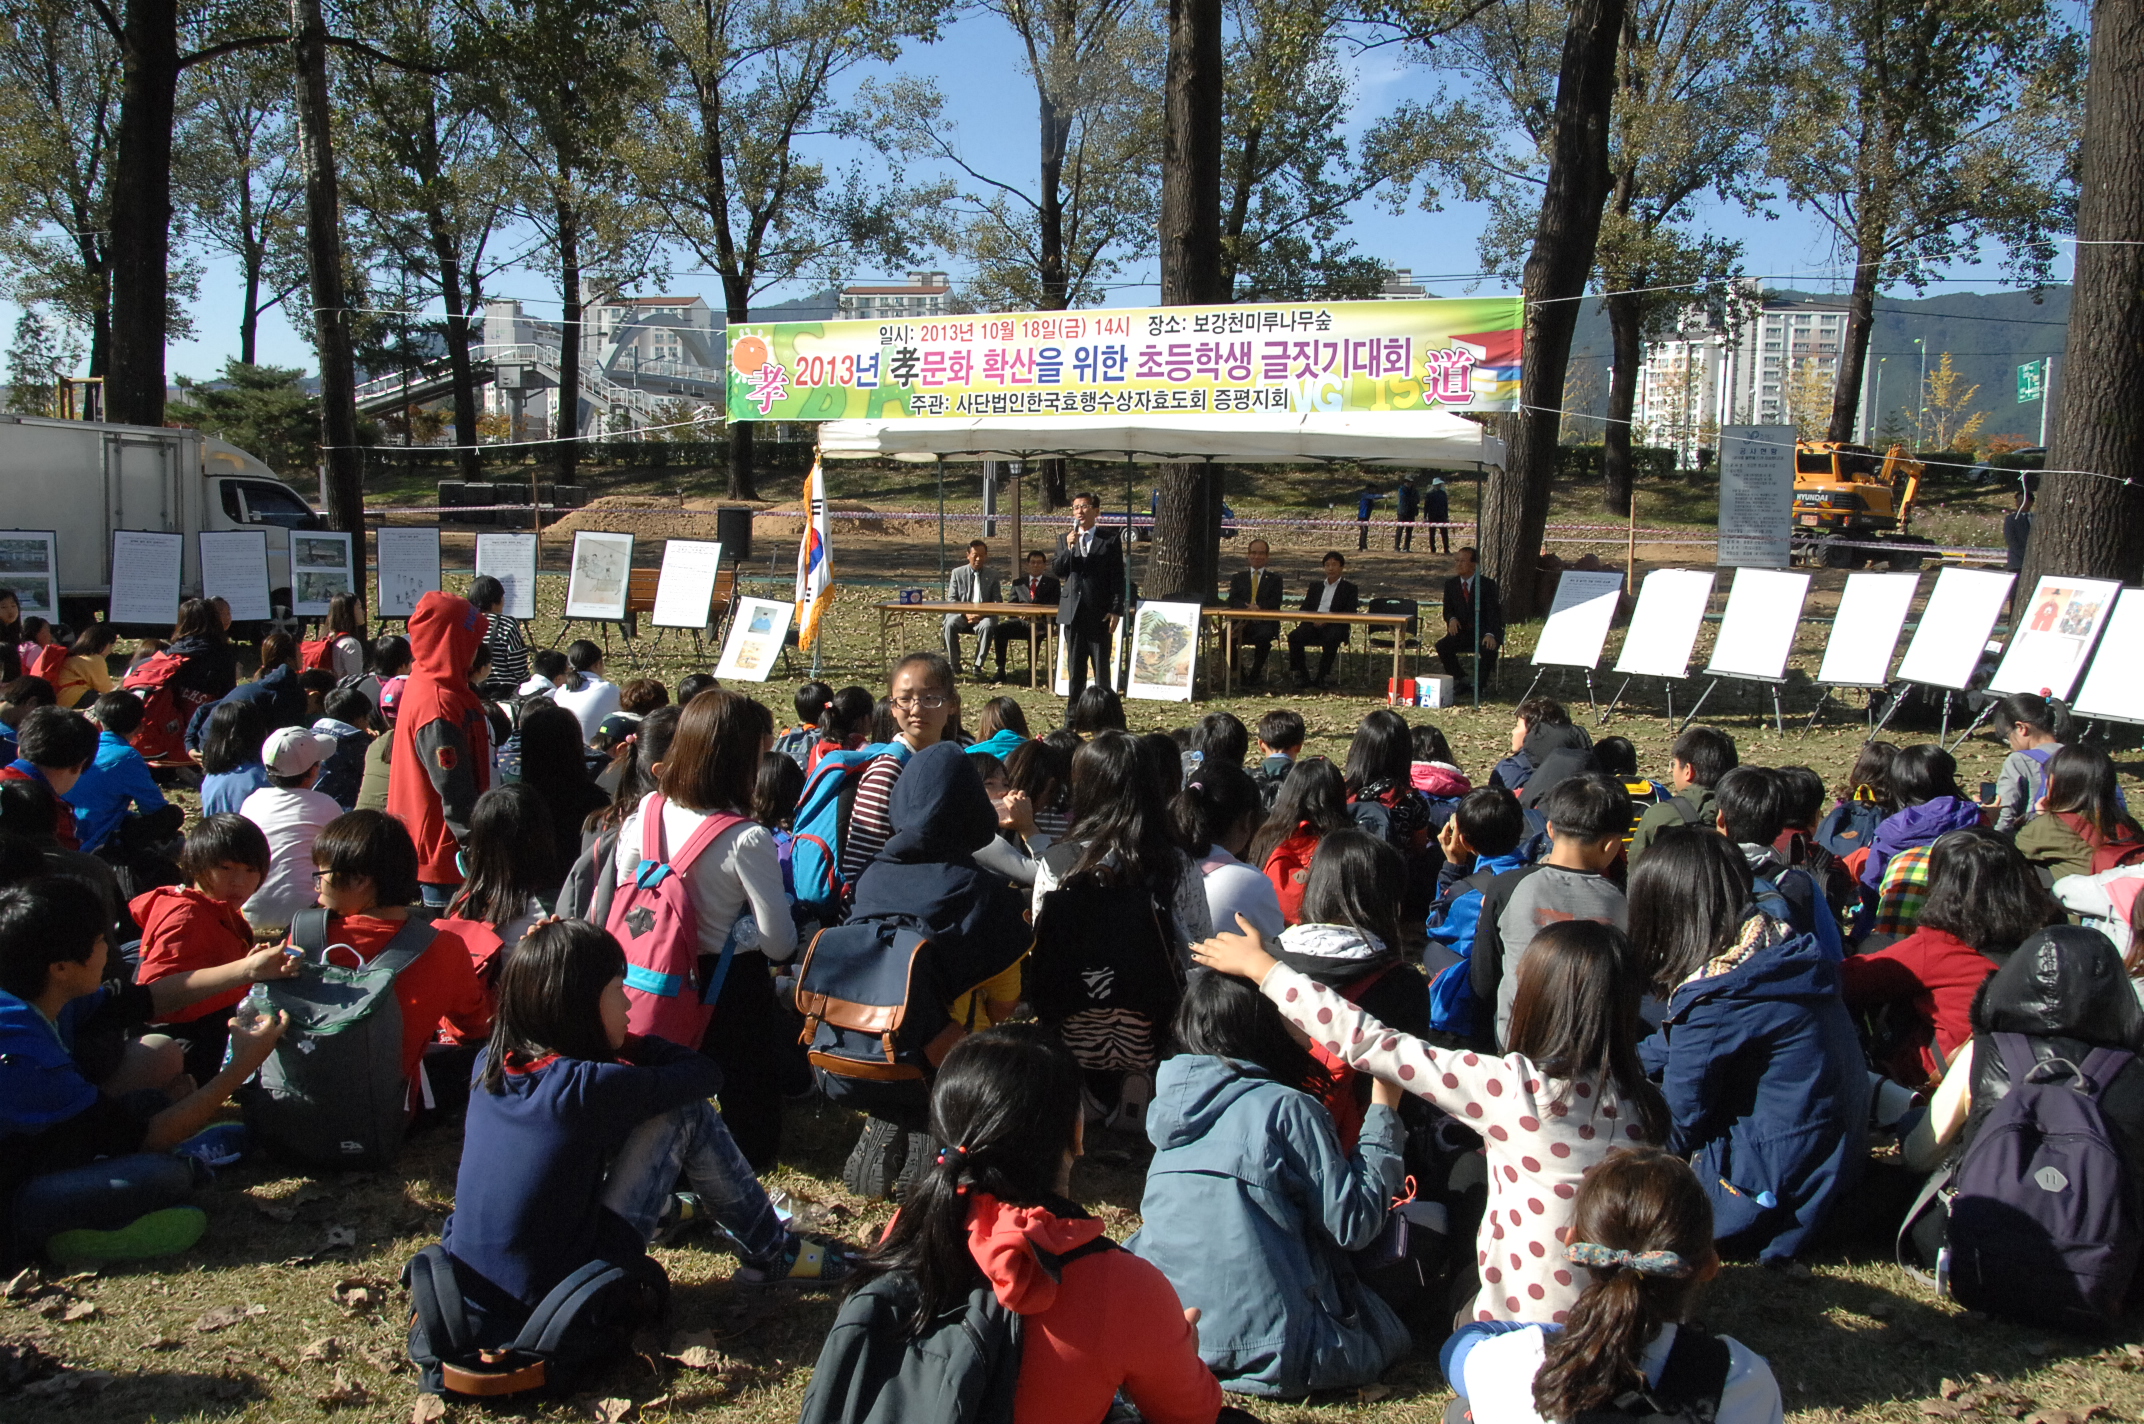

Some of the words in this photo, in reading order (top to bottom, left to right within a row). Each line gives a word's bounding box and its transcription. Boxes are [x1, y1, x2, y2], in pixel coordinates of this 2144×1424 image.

[879, 324, 914, 345] 일시:
[920, 322, 973, 343] 2013년
[980, 320, 1015, 341] 10월
[1022, 317, 1087, 340] 18일(금)
[1095, 315, 1130, 338] 14시
[1148, 314, 1187, 336] 장소:
[1193, 310, 1332, 334] 보강천미루나무숲
[794, 352, 880, 388] 2013년
[890, 346, 974, 388] 孝문화
[982, 346, 1064, 386] 확산을
[1072, 344, 1129, 383] 위한
[1135, 340, 1252, 382] 초등학생
[1261, 336, 1411, 380] 글짓기대회
[1424, 348, 1475, 403] 道
[746, 365, 789, 414] 孝
[910, 393, 950, 415] 주관:
[956, 388, 1206, 414] 사단법인한국효행수상자효도회
[1213, 387, 1288, 410] 증평지회
[1796, 493, 1829, 502] HYUNDAI
